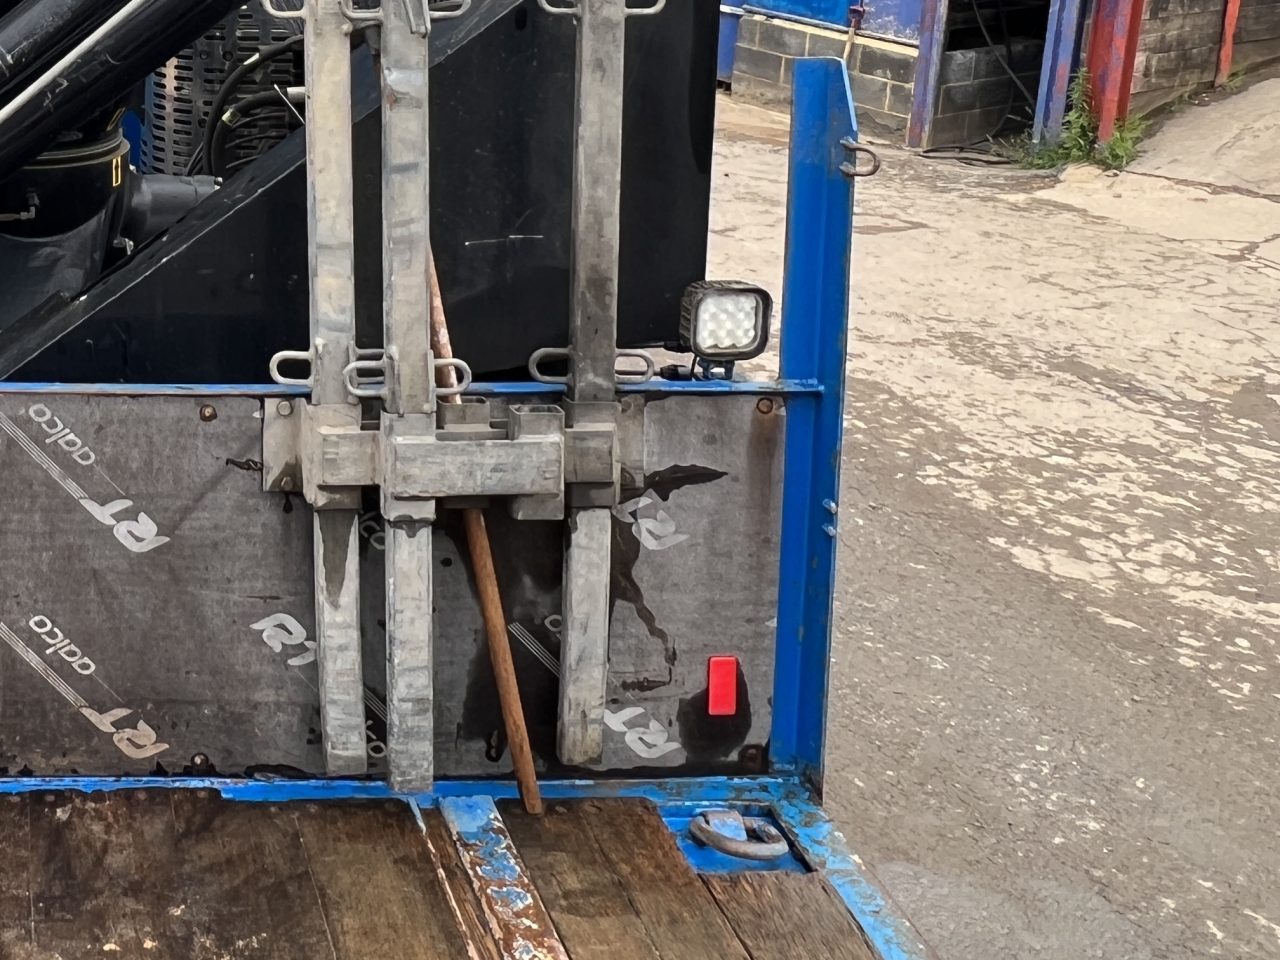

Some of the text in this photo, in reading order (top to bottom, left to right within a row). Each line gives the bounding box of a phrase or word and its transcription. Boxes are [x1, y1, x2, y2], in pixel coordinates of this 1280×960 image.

[28, 403, 96, 466] aalco
[78, 498, 170, 553] RT
[28, 615, 96, 675] aalco
[78, 707, 170, 759] RT
